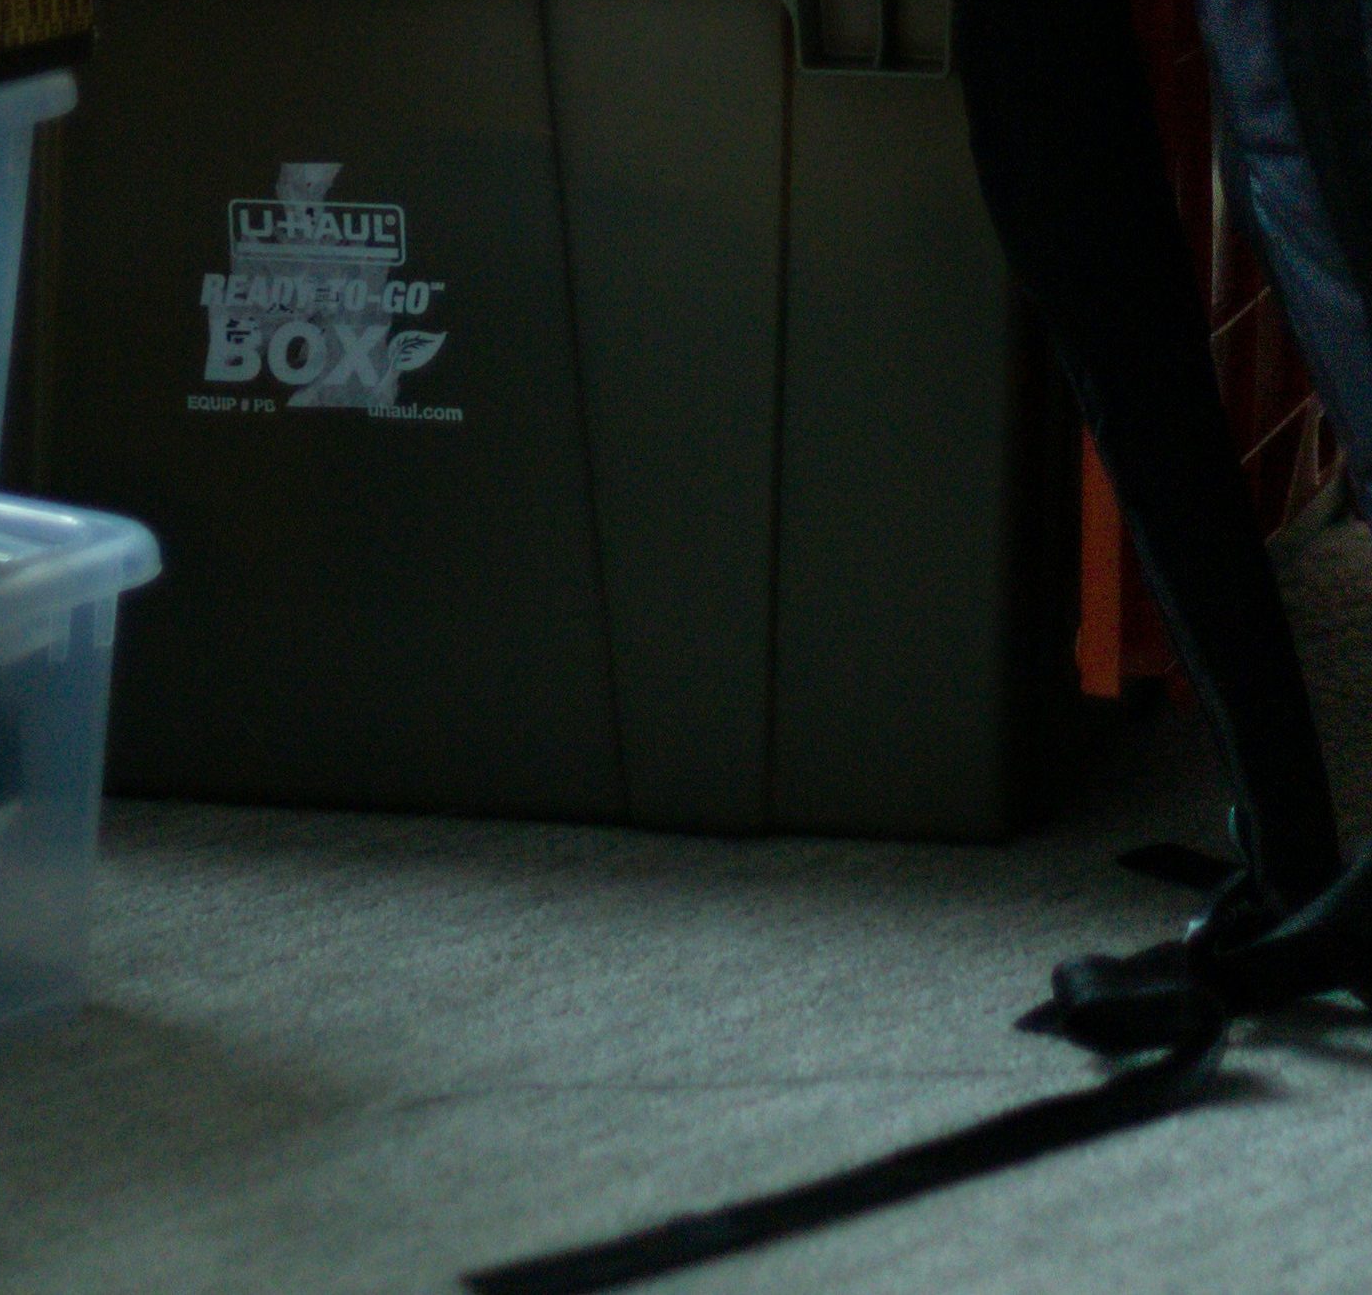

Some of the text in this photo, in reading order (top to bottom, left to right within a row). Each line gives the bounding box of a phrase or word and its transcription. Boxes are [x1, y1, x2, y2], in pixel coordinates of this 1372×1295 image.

[203, 317, 392, 388] BOX
[186, 395, 237, 412] EQUIP
[367, 402, 464, 422] uhaul.com
